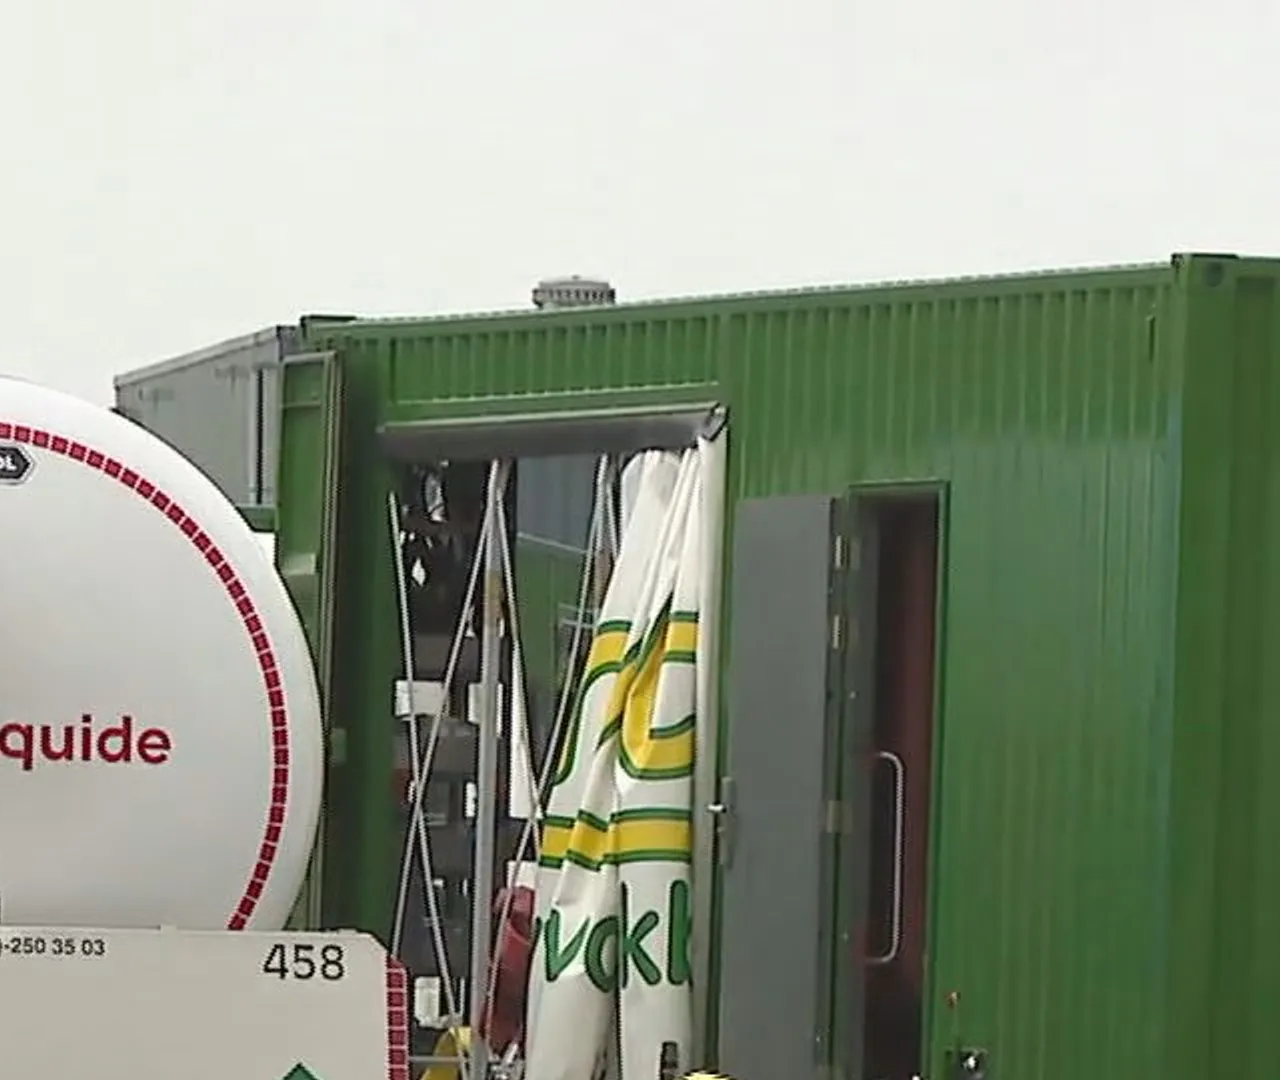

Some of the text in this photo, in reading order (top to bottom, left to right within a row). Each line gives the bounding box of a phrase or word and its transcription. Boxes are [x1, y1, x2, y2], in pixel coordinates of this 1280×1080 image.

[51, 937, 76, 956] 35
[81, 938, 106, 957] 03
[263, 944, 345, 980] 458
